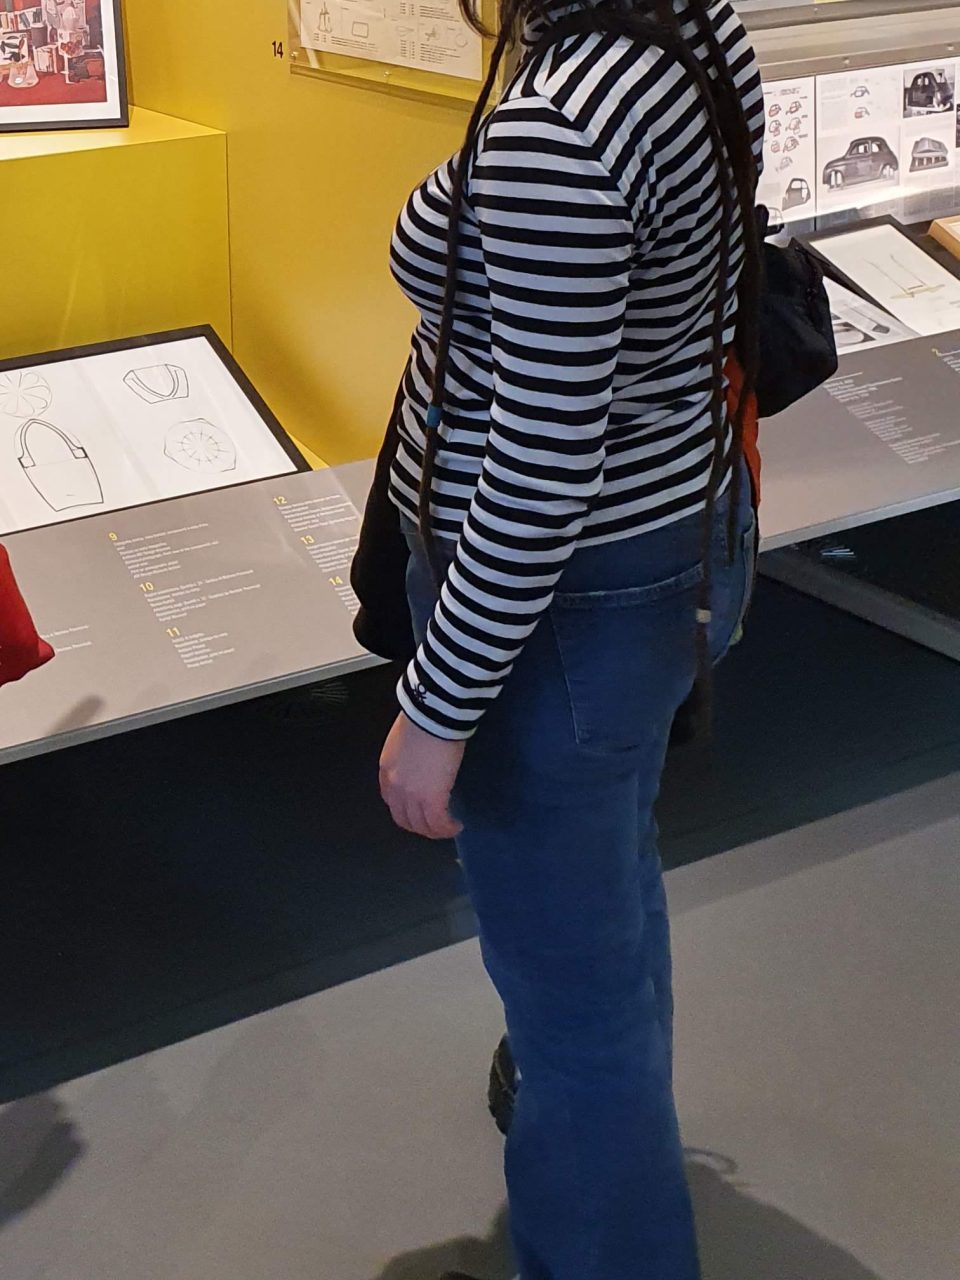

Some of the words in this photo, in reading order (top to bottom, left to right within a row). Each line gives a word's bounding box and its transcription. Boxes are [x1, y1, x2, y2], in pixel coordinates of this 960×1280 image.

[271, 40, 284, 59] 14
[273, 496, 288, 505] 12
[108, 532, 118, 541] 9
[300, 535, 315, 545] 13
[328, 576, 344, 586] 14
[139, 581, 154, 592] 10
[166, 627, 180, 637] 11
